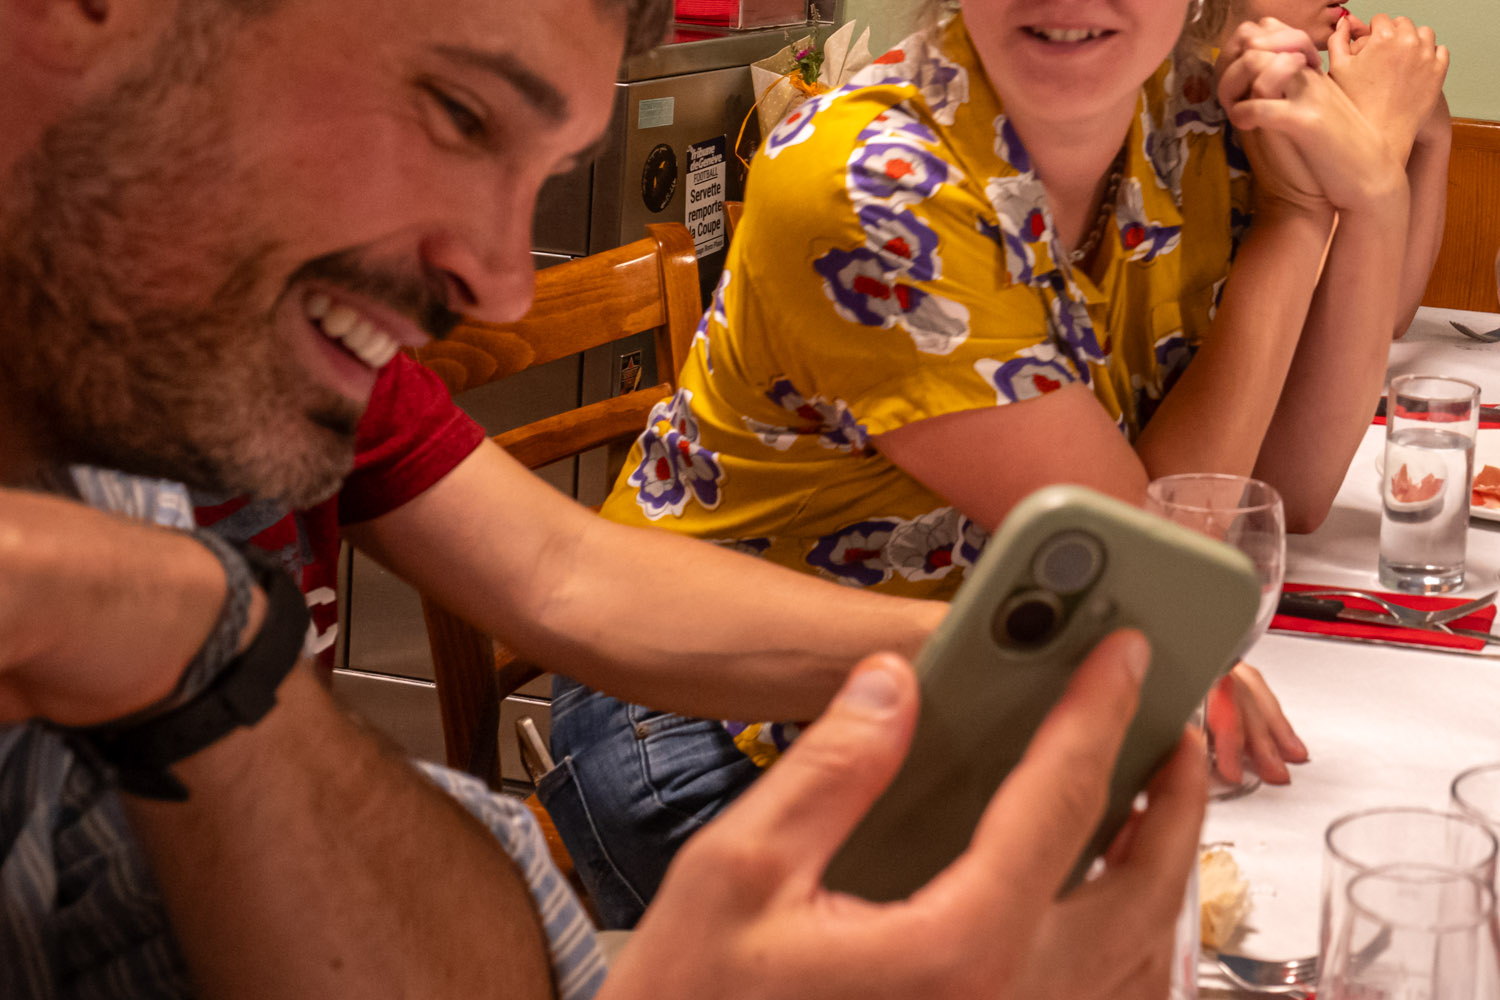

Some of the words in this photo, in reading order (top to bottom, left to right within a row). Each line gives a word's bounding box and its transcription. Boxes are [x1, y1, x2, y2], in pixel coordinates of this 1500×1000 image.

[693, 167, 718, 183] FOOTBALL
[690, 182, 721, 204] Servette
[688, 200, 722, 223] remporte
[697, 218, 720, 237] Coupe
